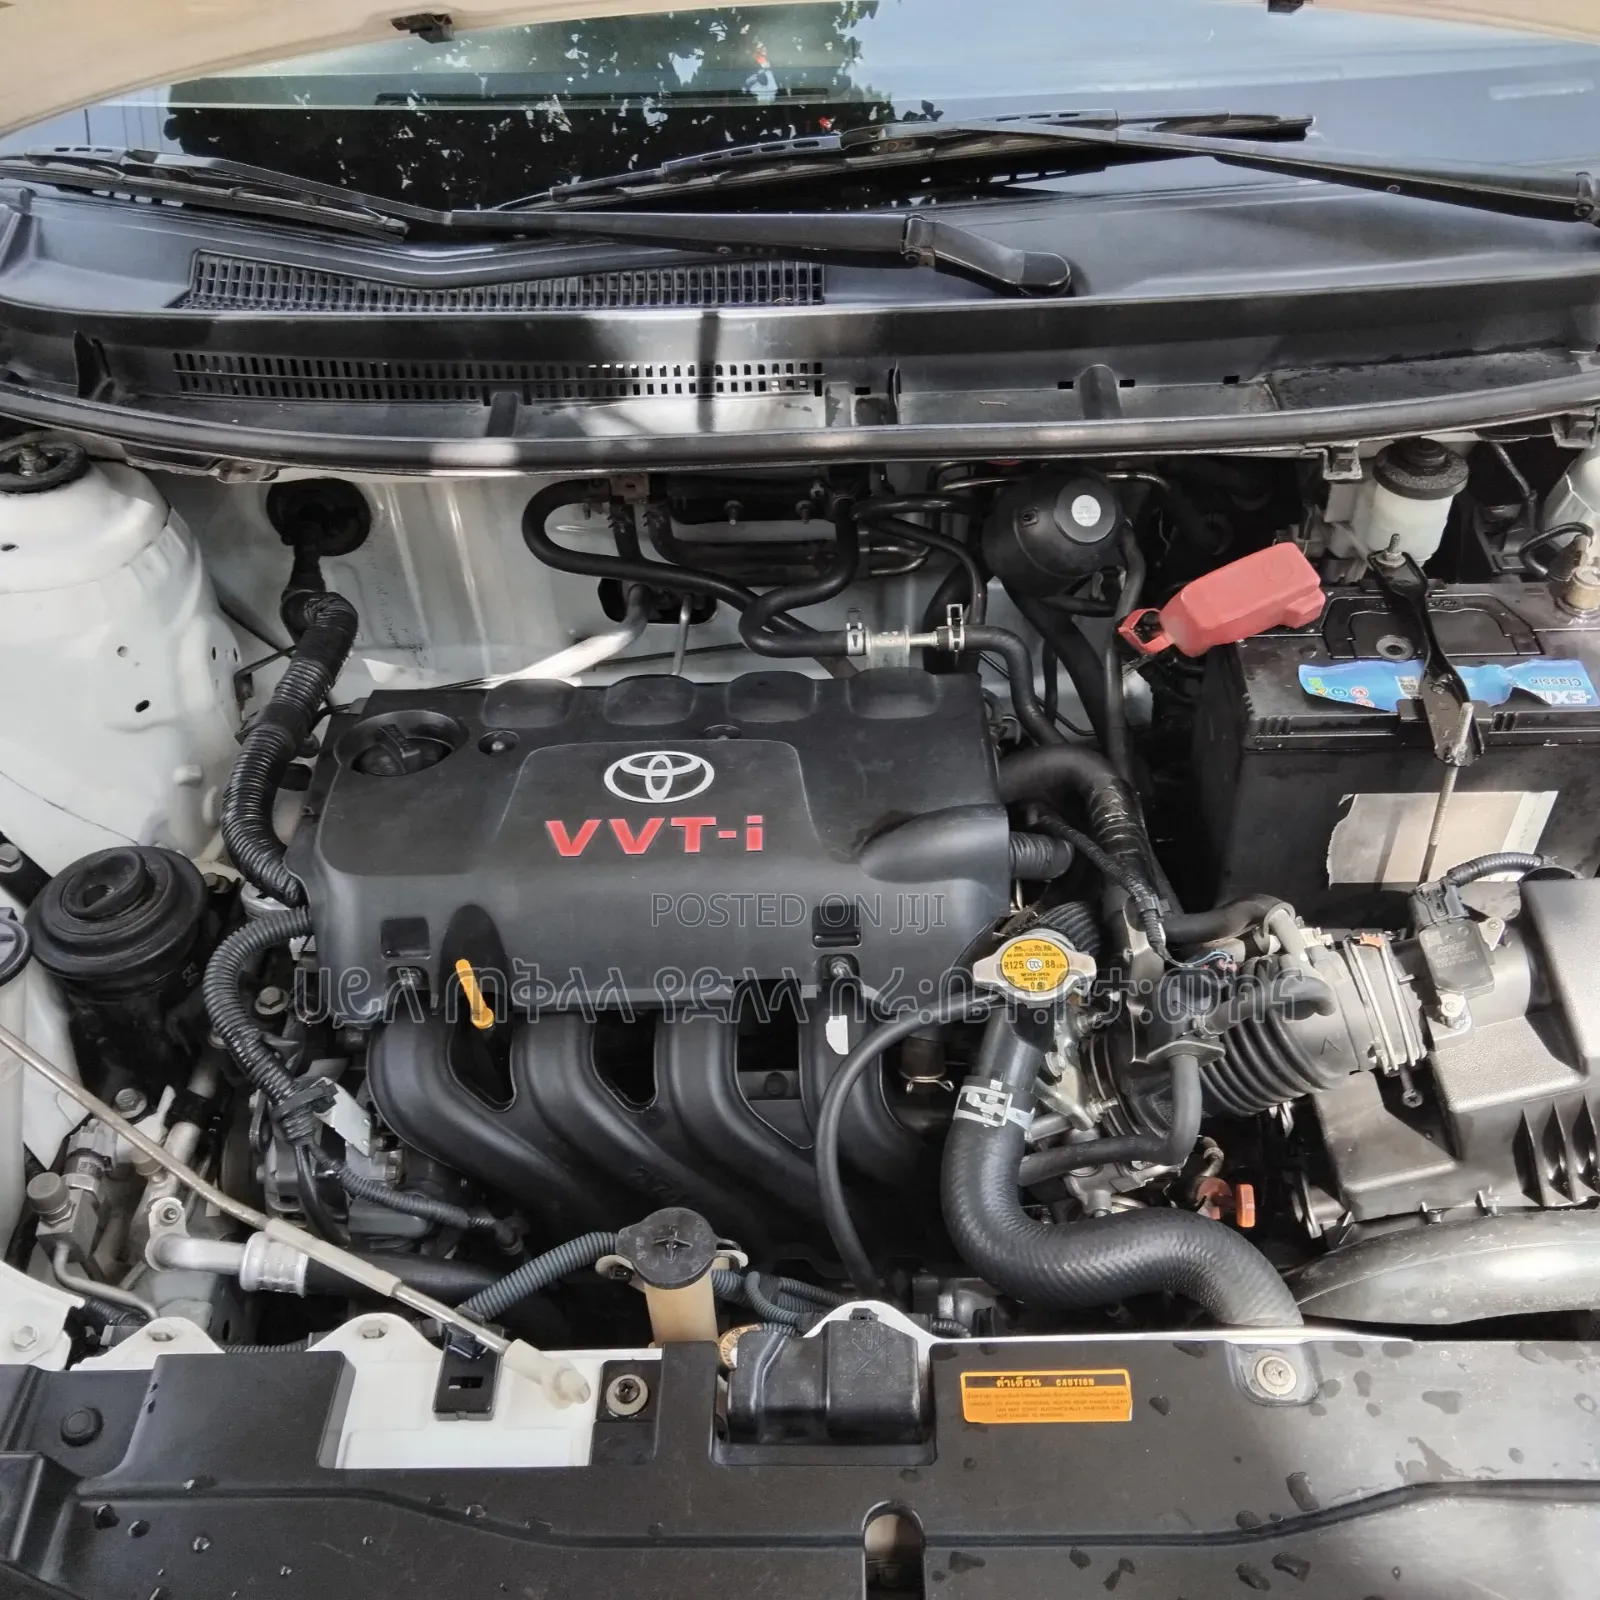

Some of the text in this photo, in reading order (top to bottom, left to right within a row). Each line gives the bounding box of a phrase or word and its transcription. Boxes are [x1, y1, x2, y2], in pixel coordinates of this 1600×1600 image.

[1530, 678, 1582, 687] Classic
[545, 815, 763, 857] VVT-i
[1004, 960, 1024, 970] R125
[1045, 959, 1055, 968] 88
[1056, 1378, 1095, 1387] CAUTION
